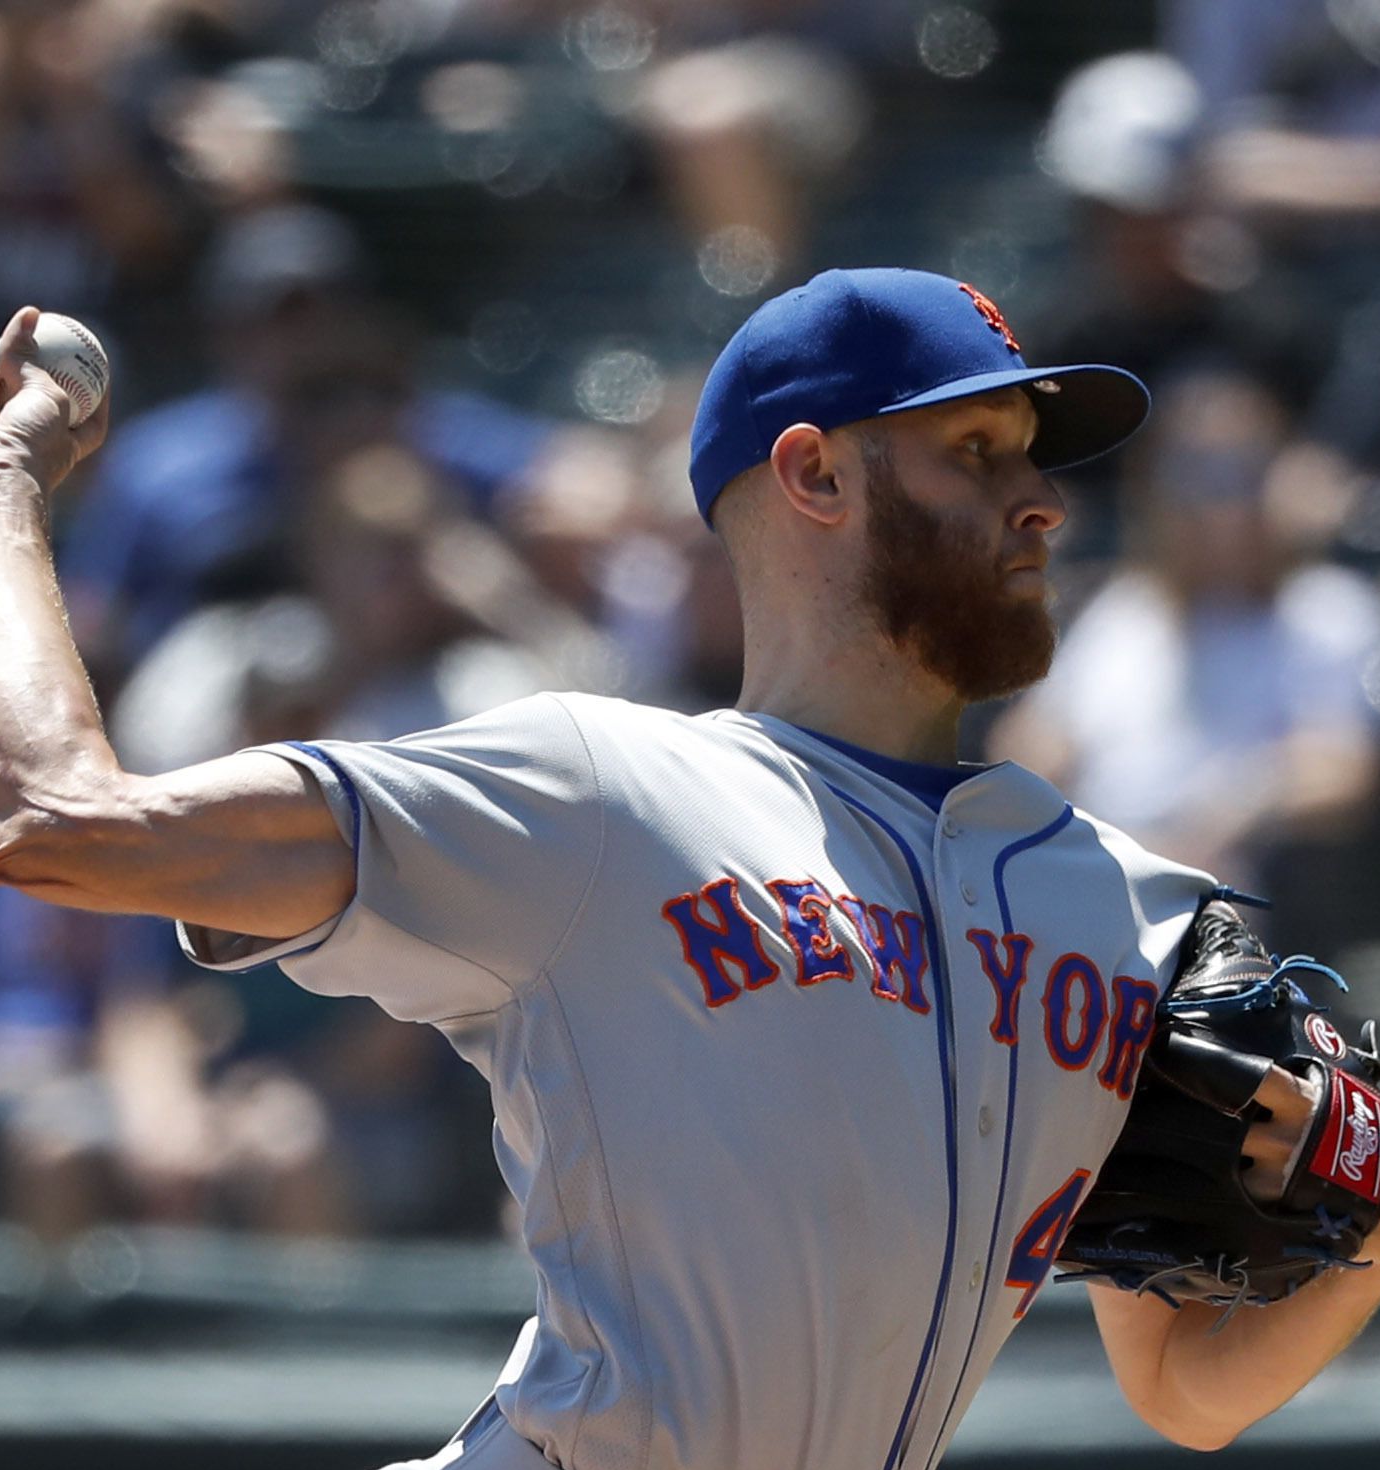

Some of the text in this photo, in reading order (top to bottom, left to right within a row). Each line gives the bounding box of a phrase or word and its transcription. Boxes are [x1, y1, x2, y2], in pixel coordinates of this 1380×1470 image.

[661, 877, 1159, 1101] NEW YOR
[1339, 1090, 1378, 1182] Rawlings
